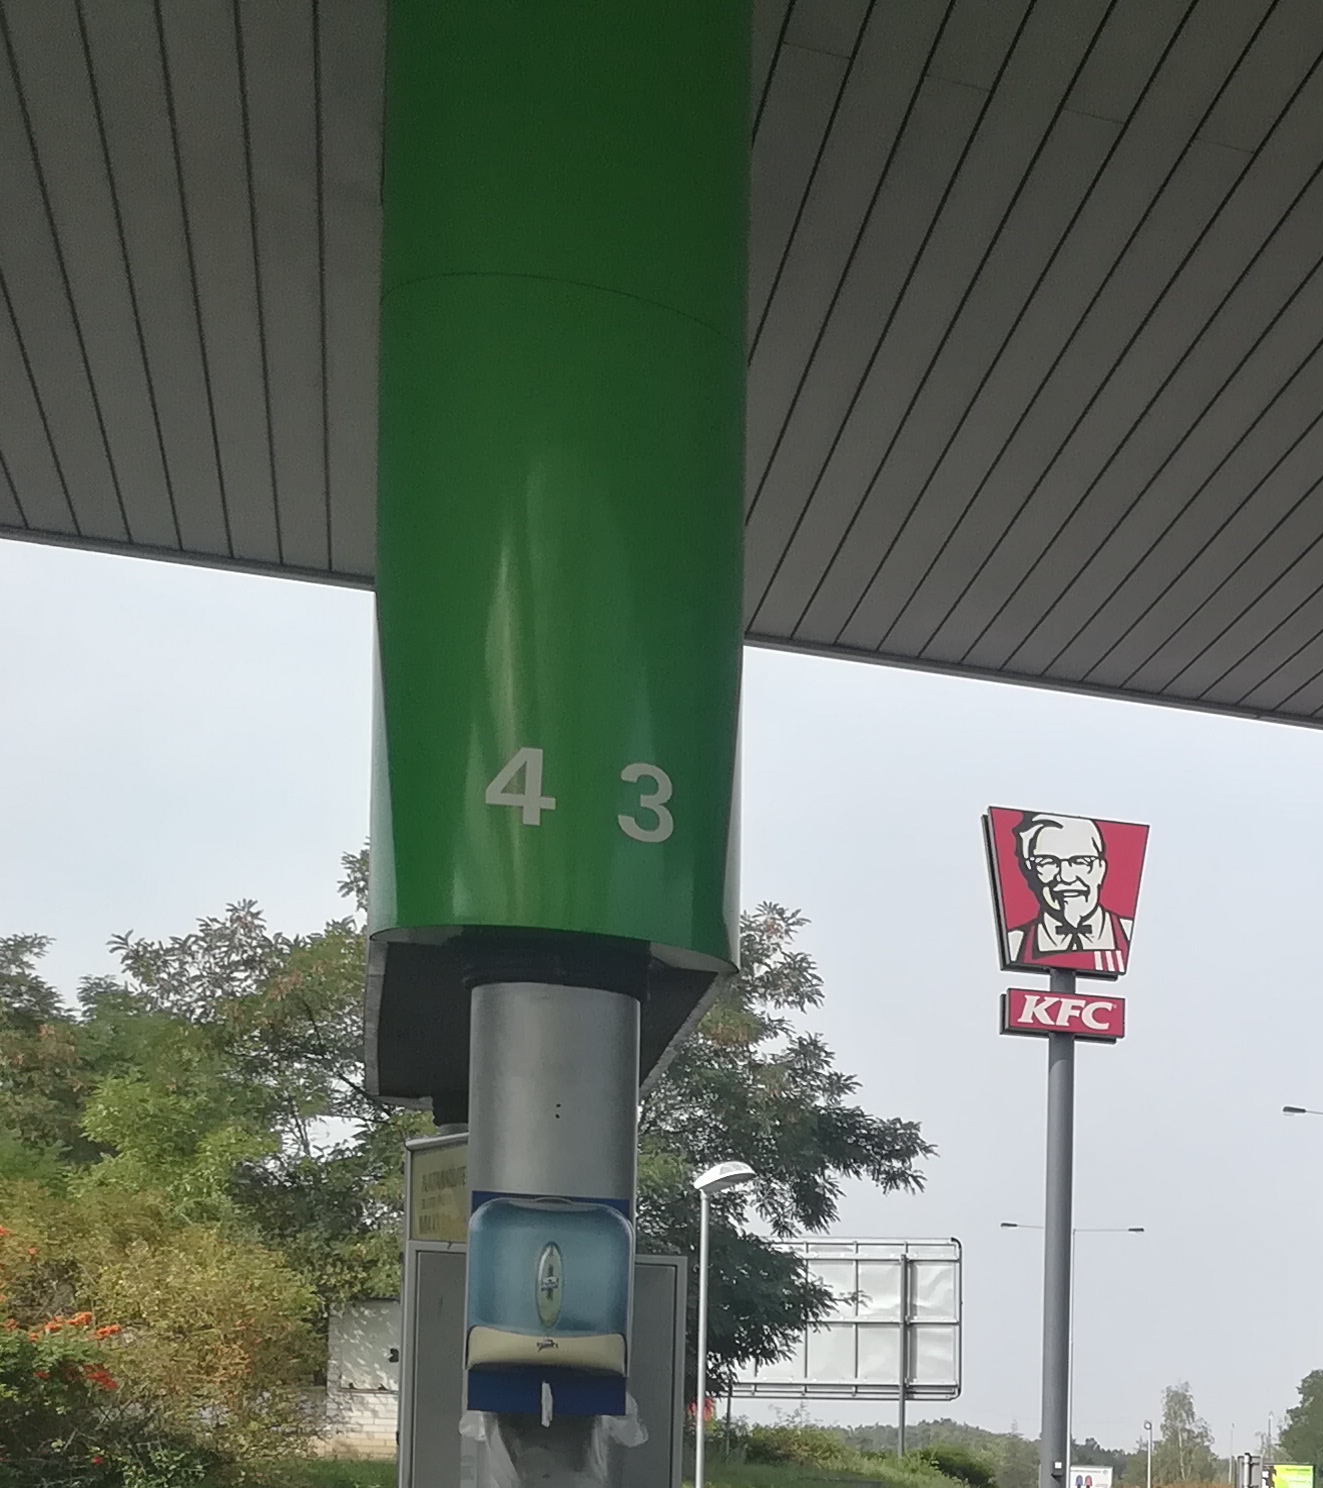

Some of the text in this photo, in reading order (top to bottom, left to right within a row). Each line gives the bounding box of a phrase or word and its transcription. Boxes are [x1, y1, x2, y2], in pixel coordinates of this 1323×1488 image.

[485, 747, 674, 843] 4 3
[1017, 994, 1114, 1030] KFC
